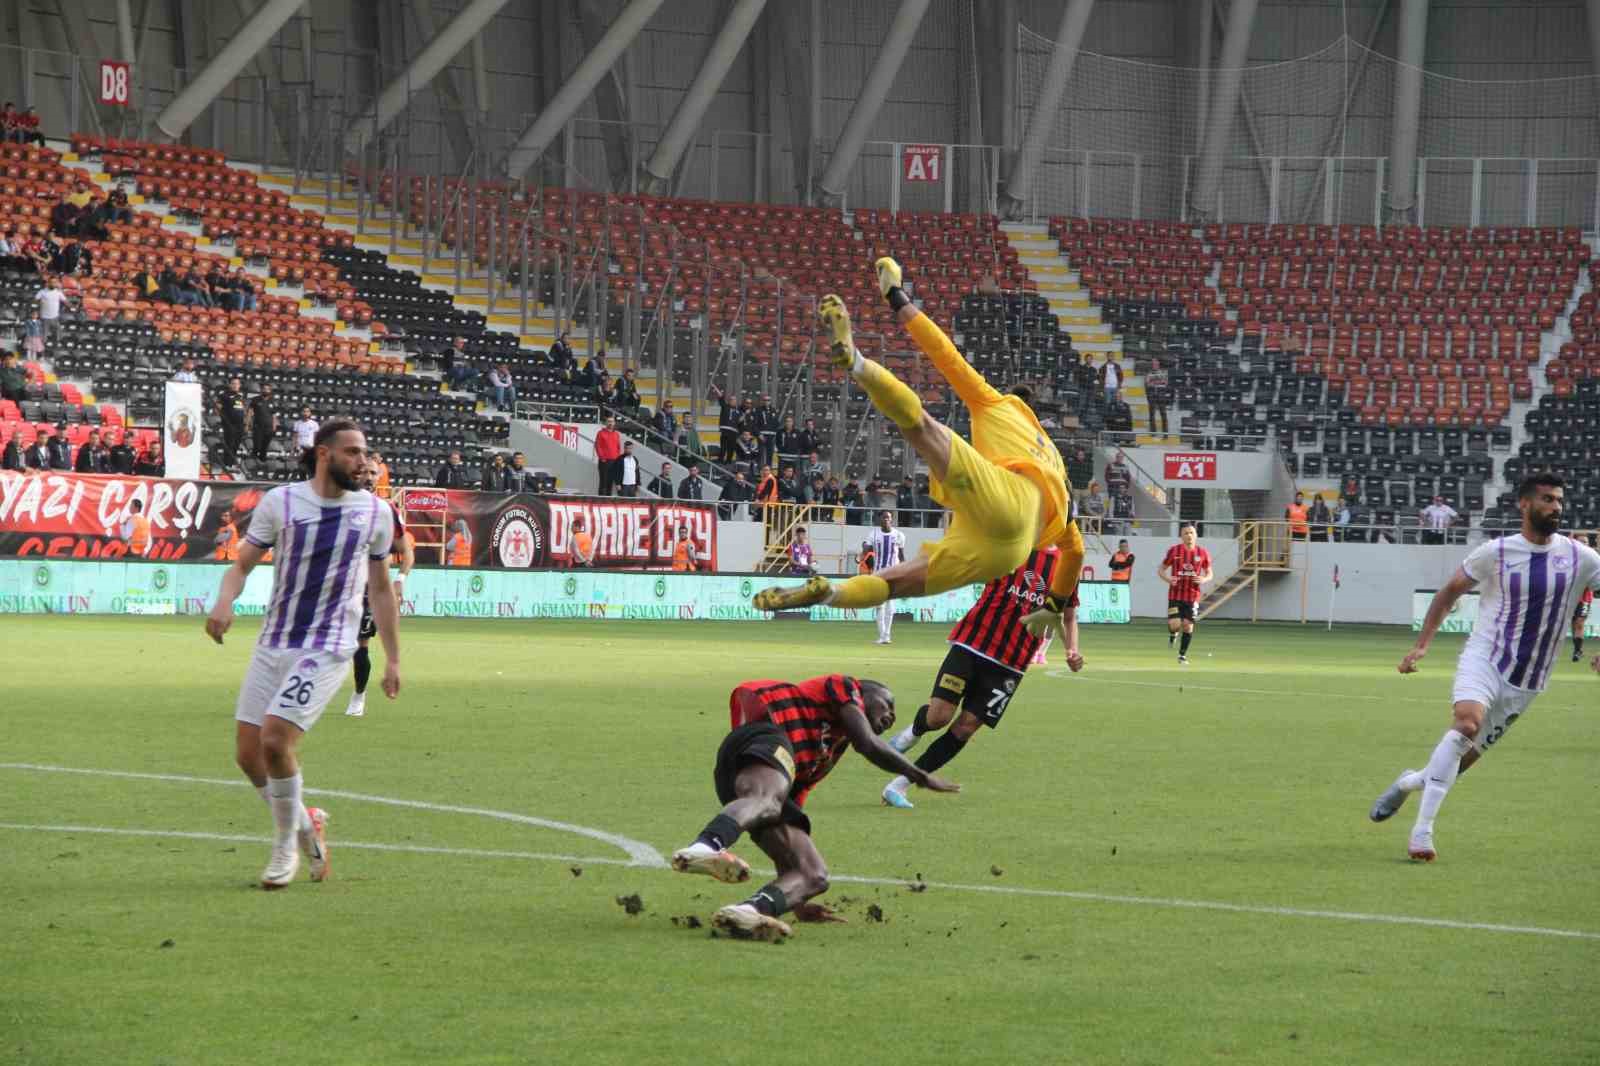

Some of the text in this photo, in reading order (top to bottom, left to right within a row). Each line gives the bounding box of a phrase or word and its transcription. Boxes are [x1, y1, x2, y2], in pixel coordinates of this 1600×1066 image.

[102, 65, 128, 102] D8
[908, 155, 938, 179] A1
[1177, 462, 1204, 477] A1
[281, 675, 314, 705] 26
